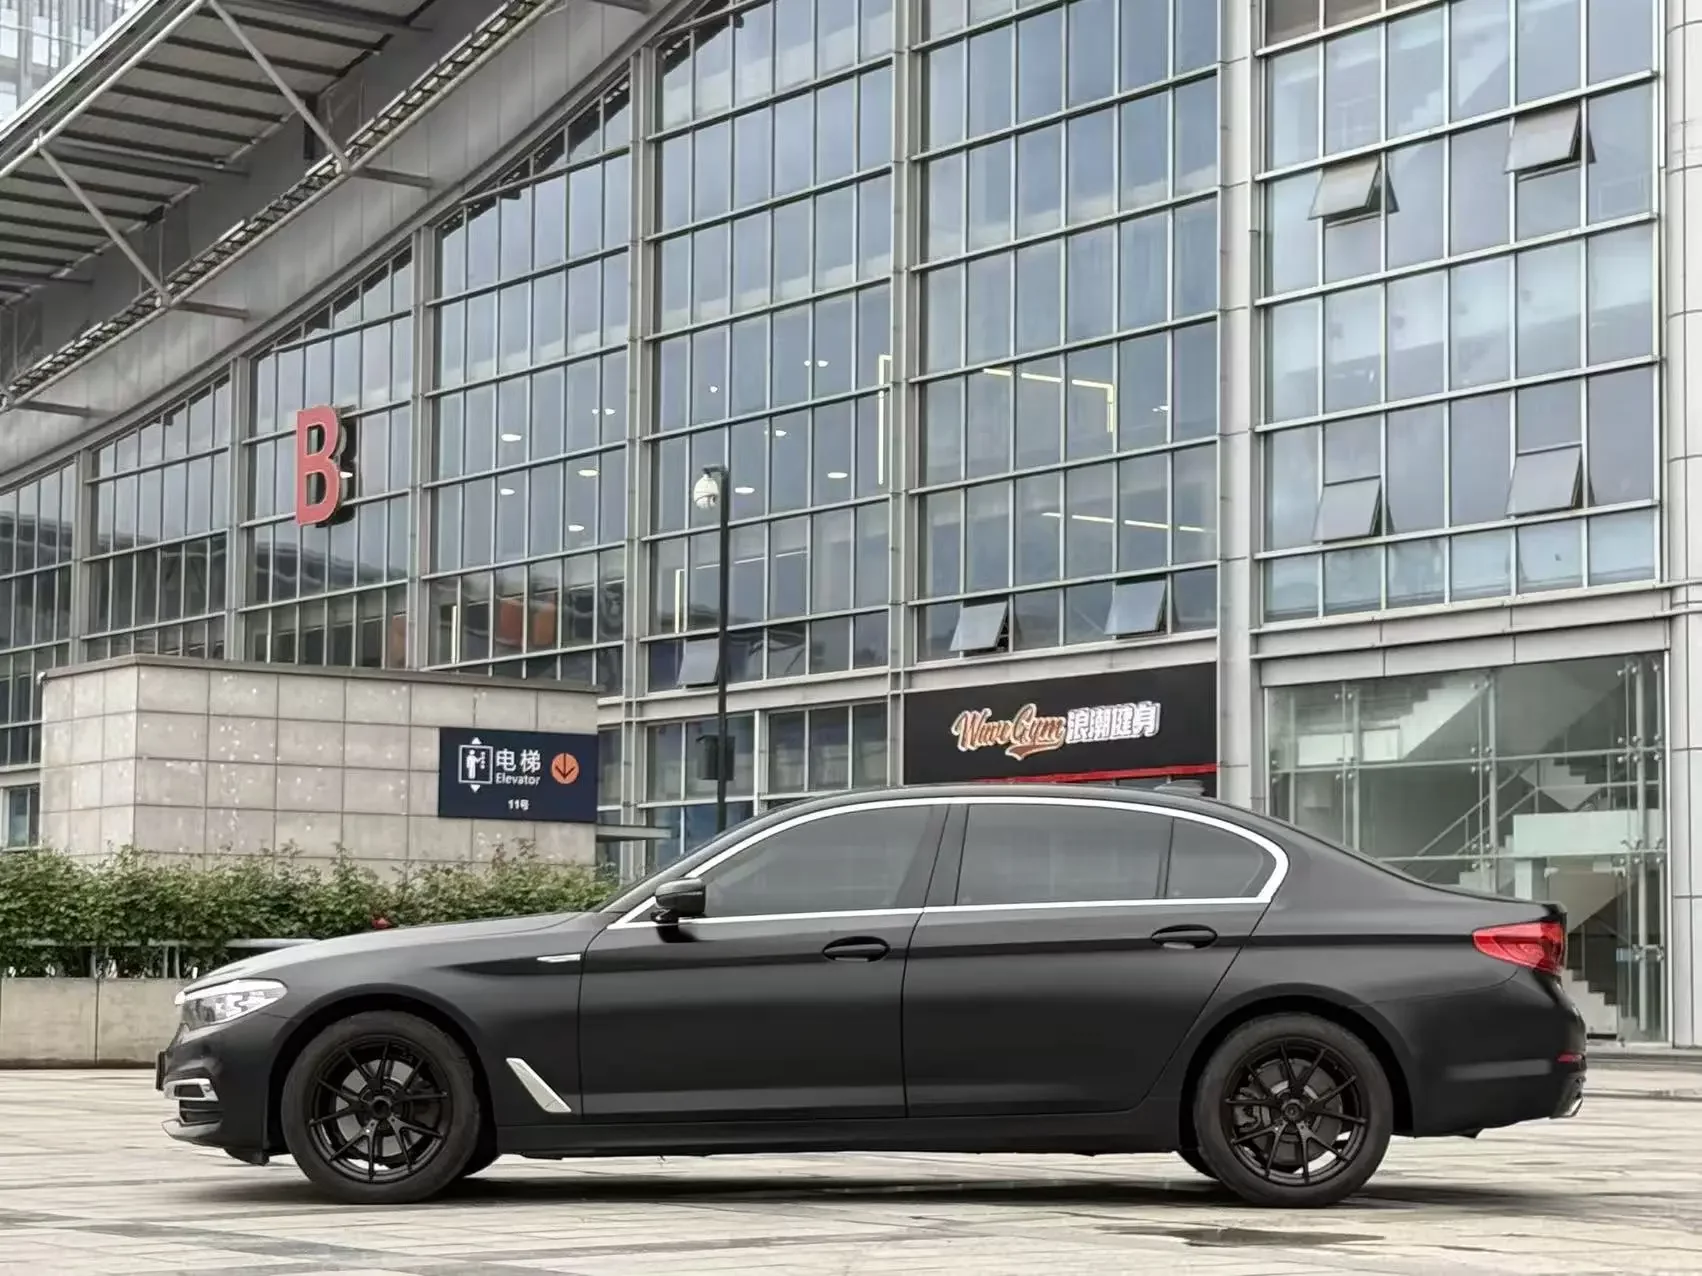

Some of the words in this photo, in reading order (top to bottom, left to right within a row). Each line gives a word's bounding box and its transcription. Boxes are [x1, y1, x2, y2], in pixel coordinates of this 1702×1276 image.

[295, 405, 341, 525] B
[1009, 703, 1066, 761] Gym
[496, 748, 541, 773] 电梯
[495, 772, 541, 787] Elevator
[507, 798, 530, 811] 11号
